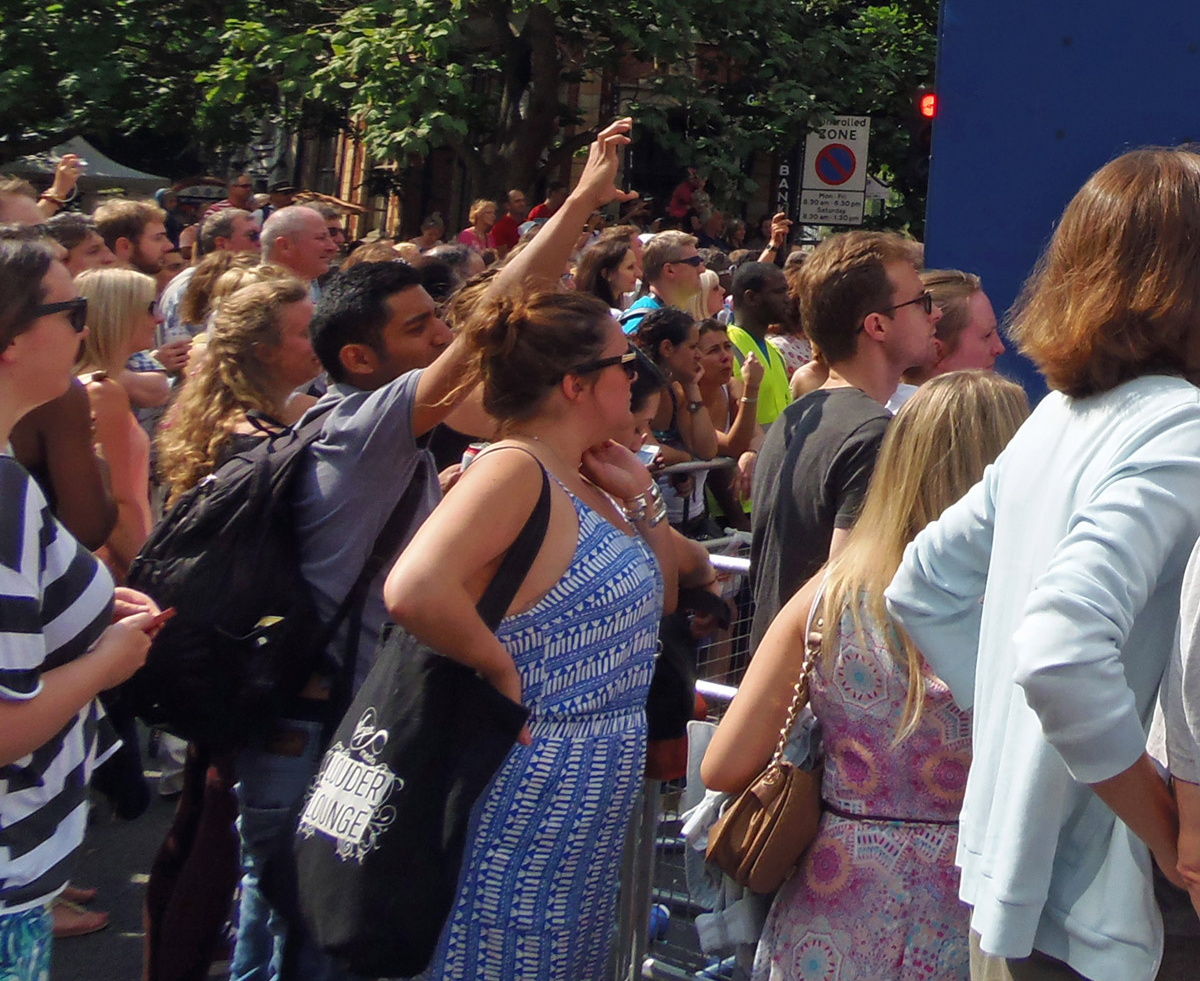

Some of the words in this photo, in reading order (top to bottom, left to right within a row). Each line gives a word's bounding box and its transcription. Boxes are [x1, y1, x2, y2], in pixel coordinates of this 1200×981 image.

[819, 128, 857, 140] ZONE
[817, 207, 846, 215] Saturday
[325, 755, 387, 801] LOUDER
[305, 791, 369, 839] LOUNGE
